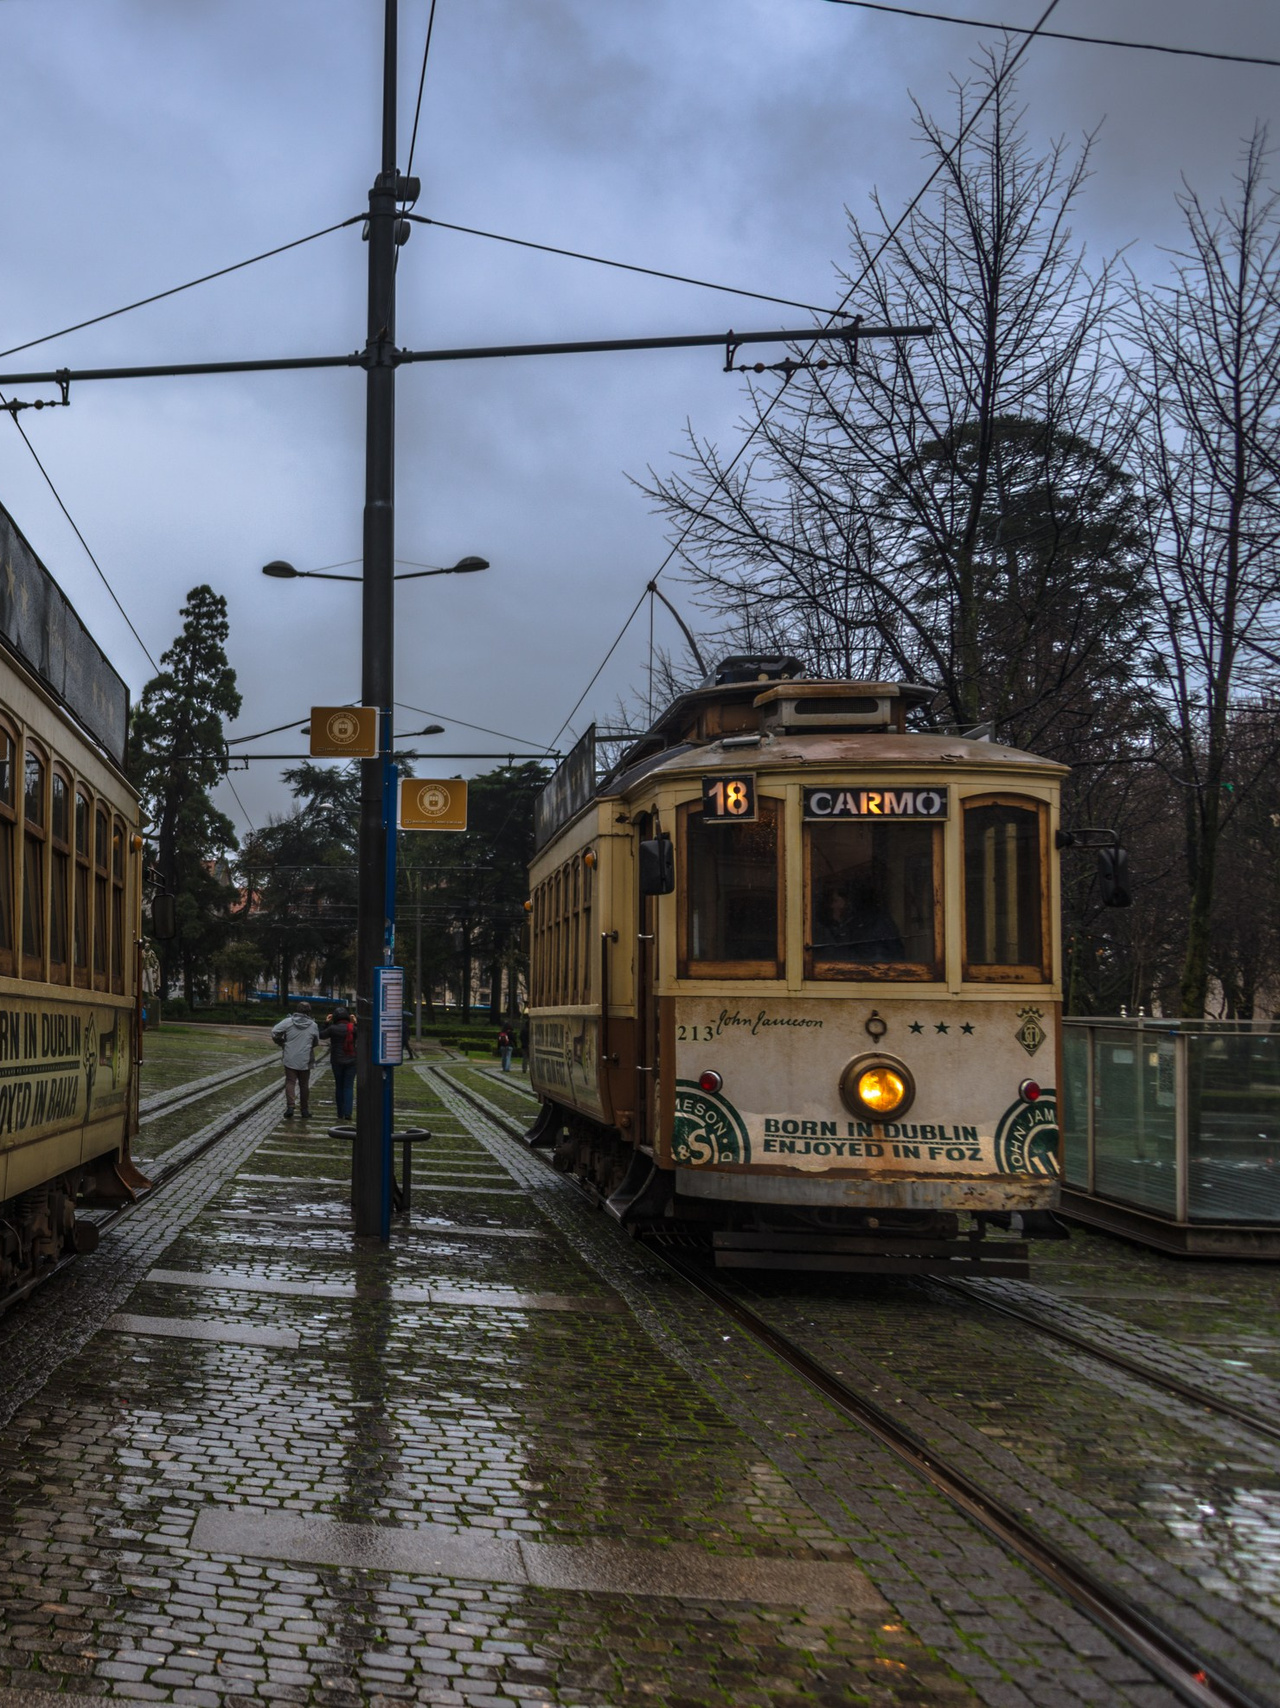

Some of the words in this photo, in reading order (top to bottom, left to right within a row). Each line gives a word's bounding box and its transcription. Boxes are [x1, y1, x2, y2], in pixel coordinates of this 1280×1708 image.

[708, 780, 749, 816] 18
[810, 790, 941, 816] CARMO
[677, 1025, 713, 1041] 213
[716, 1009, 752, 1035] John
[751, 1010, 823, 1035] Jameson
[24, 1012, 37, 1059] IN
[41, 1013, 81, 1058] DUBLIN
[31, 1080, 48, 1127] IN
[46, 1075, 79, 1122] BAIXA
[764, 1118, 837, 1136] BORN
[847, 1122, 874, 1137] IN
[883, 1123, 980, 1141] DUBLIN
[763, 1138, 885, 1158] ENJOYED
[893, 1144, 920, 1159] IN
[928, 1146, 984, 1161] FOZ
[1011, 1126, 1026, 1174] OHN
